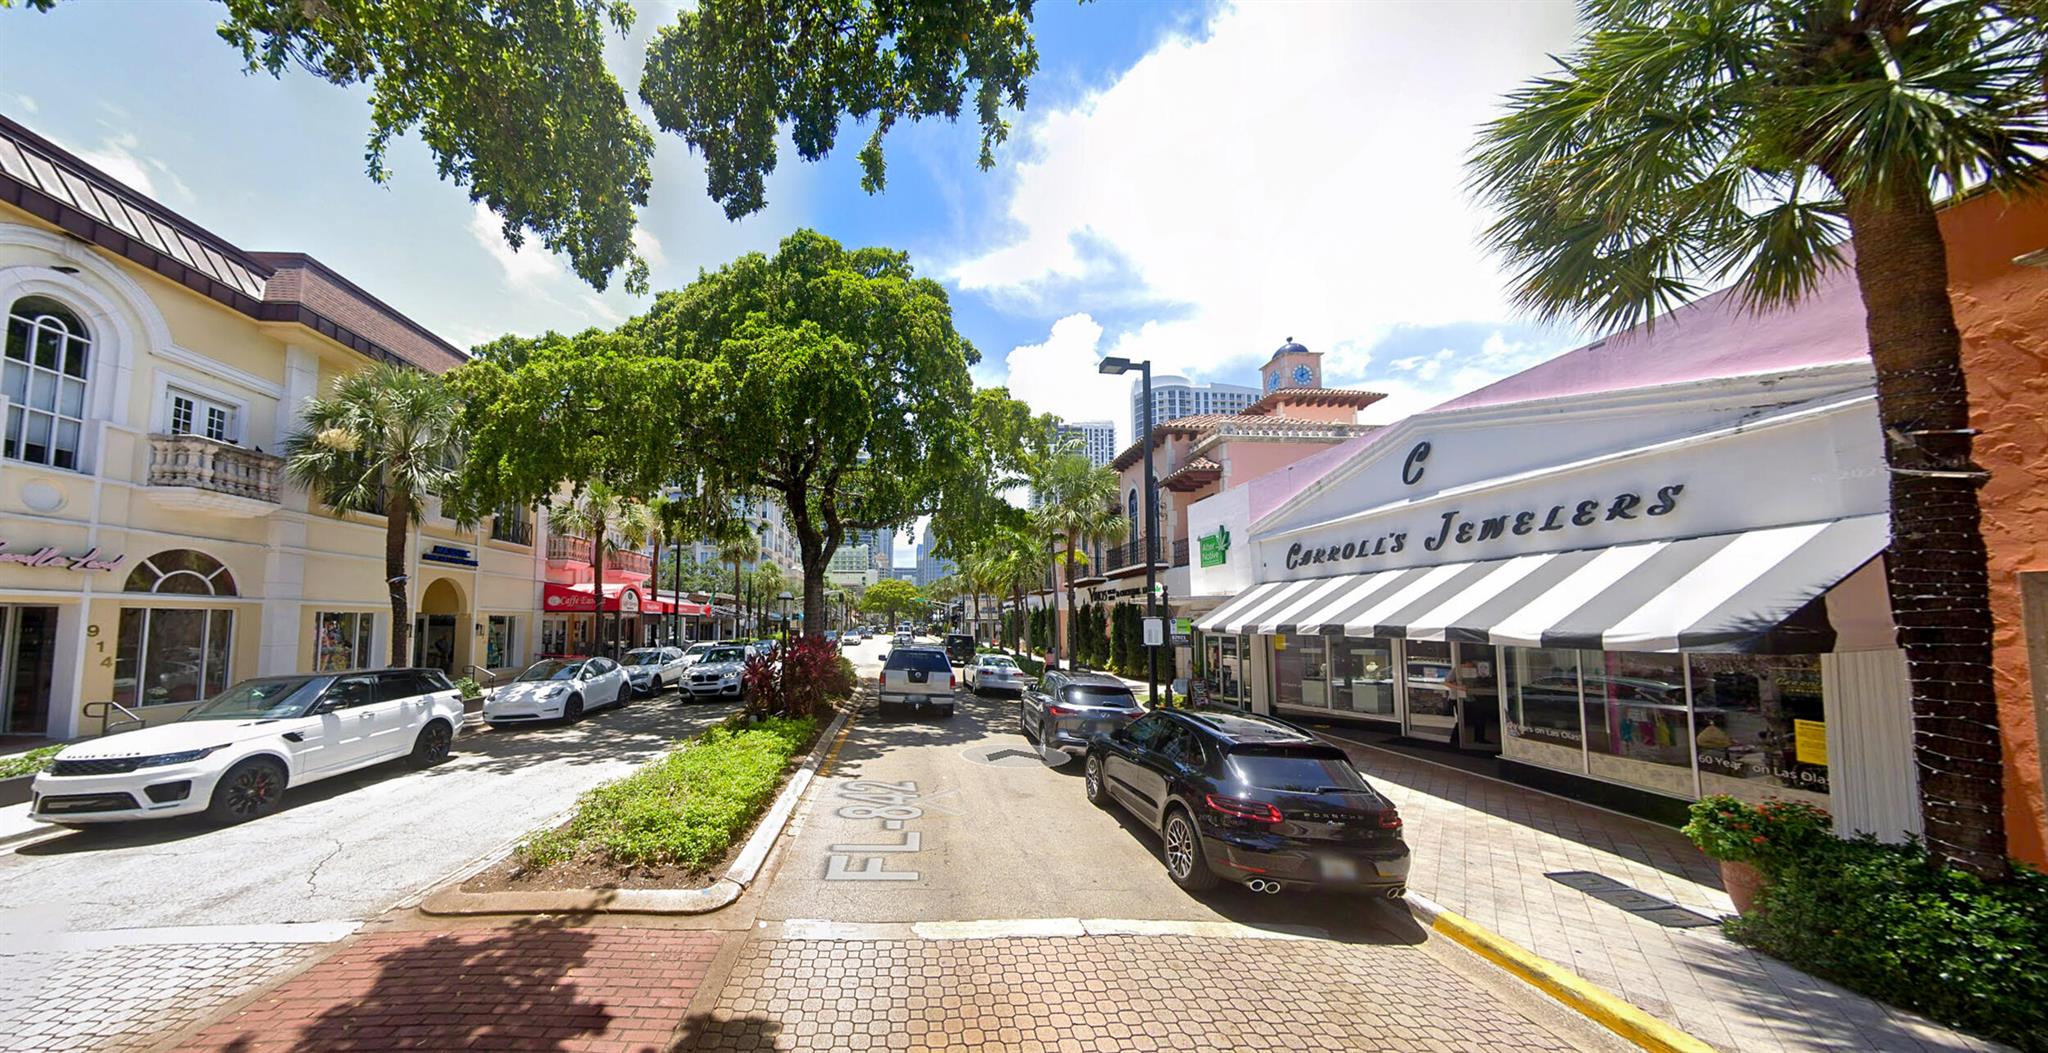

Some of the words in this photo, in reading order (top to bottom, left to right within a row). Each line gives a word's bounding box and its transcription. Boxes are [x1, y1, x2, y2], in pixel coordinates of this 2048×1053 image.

[1402, 441, 1431, 486] C
[1424, 483, 1685, 552] JEWELERS
[86, 624, 113, 669] 914
[1752, 764, 1770, 775] on
[1774, 767, 1798, 780] Las
